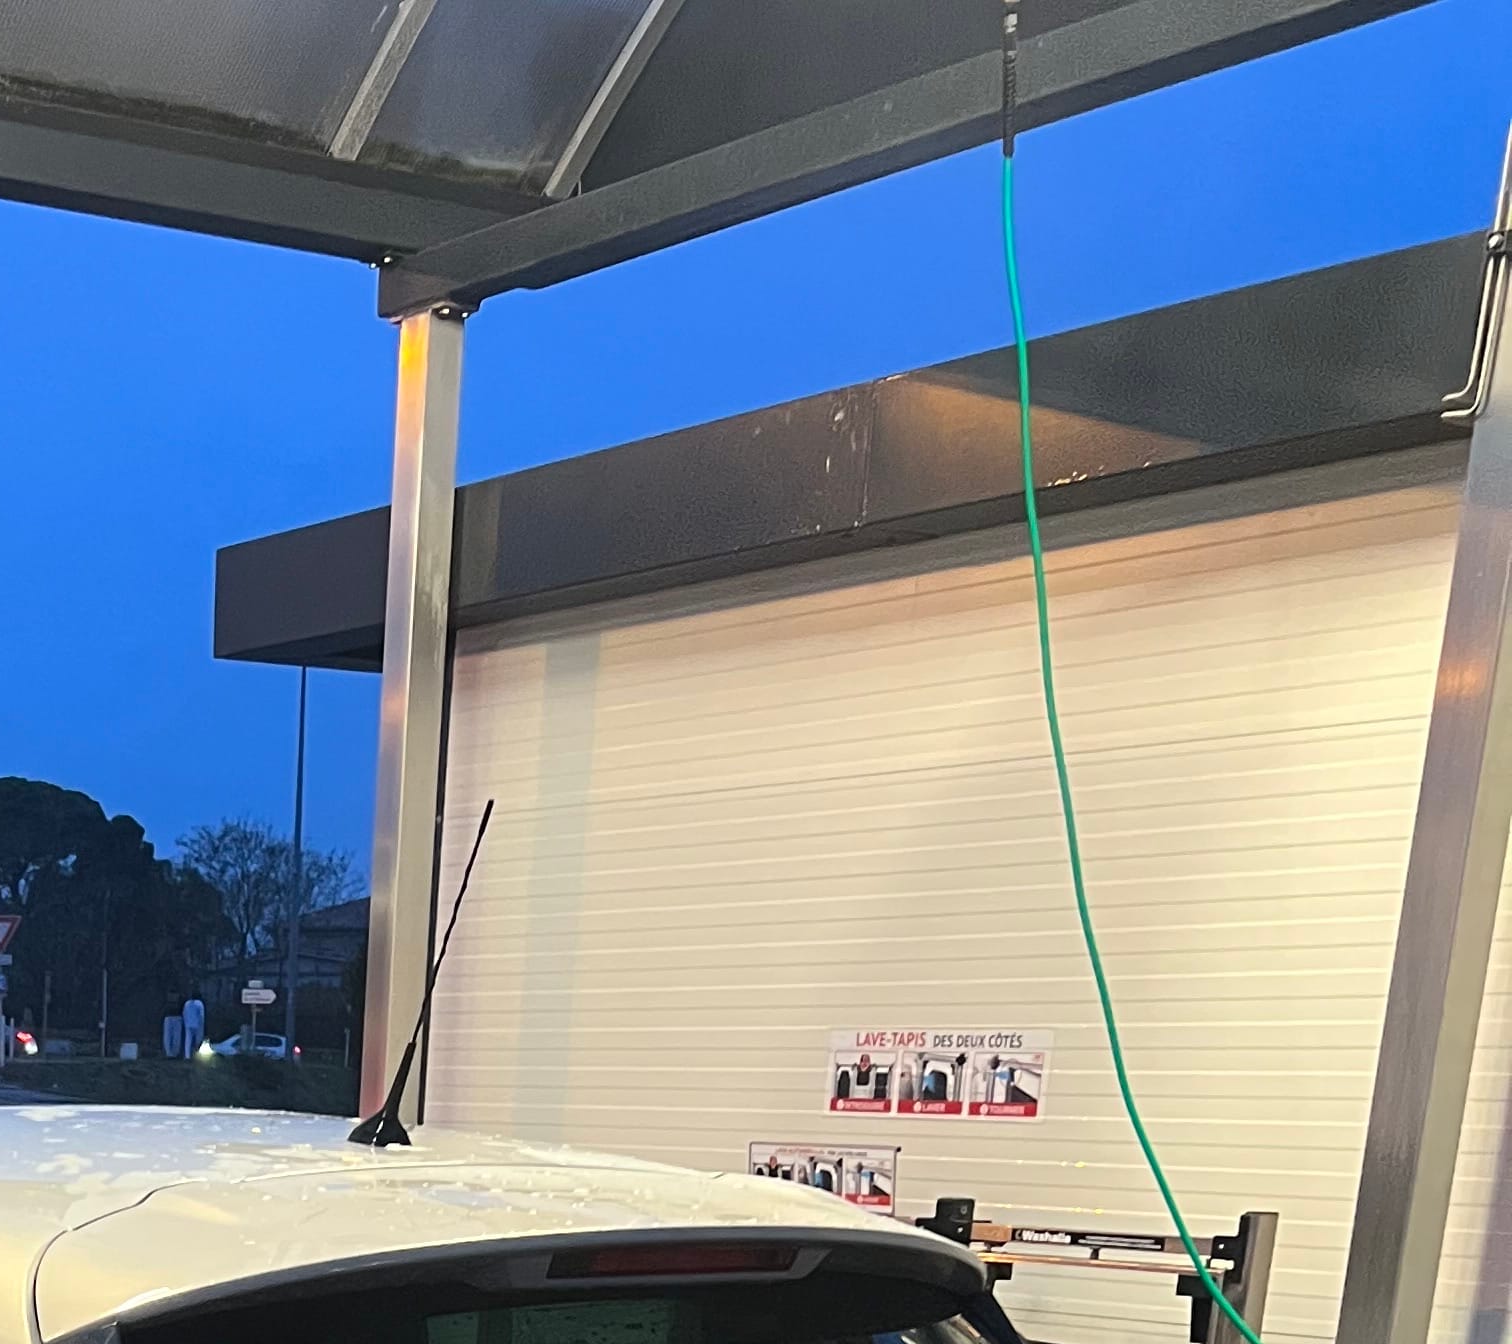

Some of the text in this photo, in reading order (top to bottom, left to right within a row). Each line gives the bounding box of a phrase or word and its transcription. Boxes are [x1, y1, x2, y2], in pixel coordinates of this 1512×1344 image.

[855, 1031, 1023, 1048] LAVE-TAPIS DES DEUX CÔTÉS
